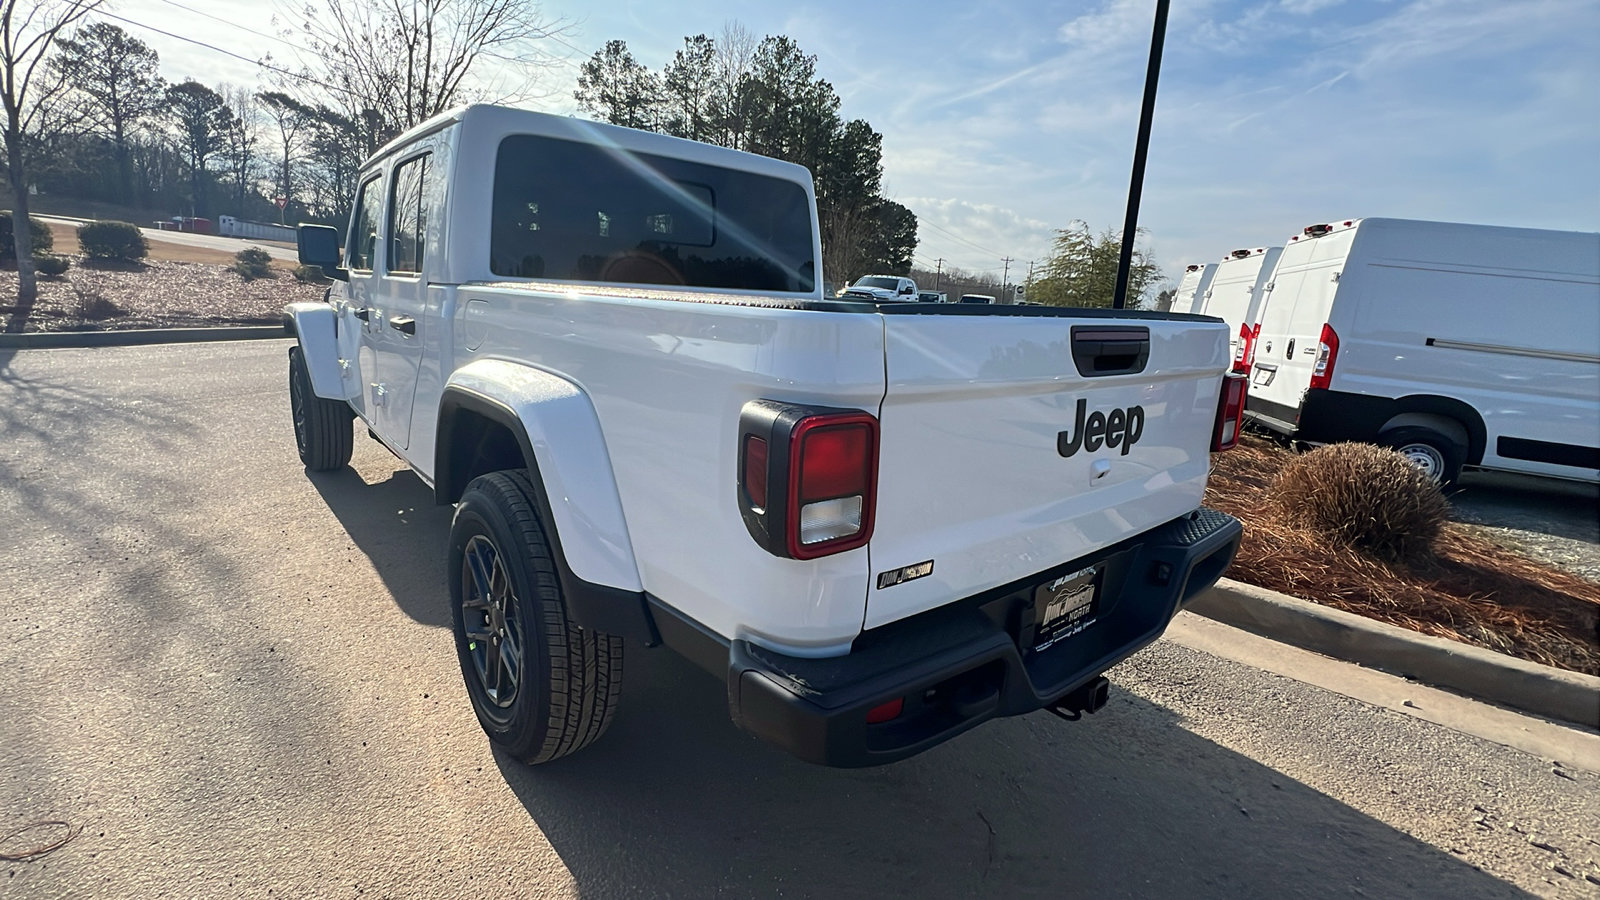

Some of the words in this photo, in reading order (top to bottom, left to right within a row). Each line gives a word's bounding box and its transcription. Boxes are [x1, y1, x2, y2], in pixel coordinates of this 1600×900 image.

[1057, 398, 1144, 458] Jeep
[1042, 602, 1063, 627] DON
[1068, 603, 1091, 622] NORTH
